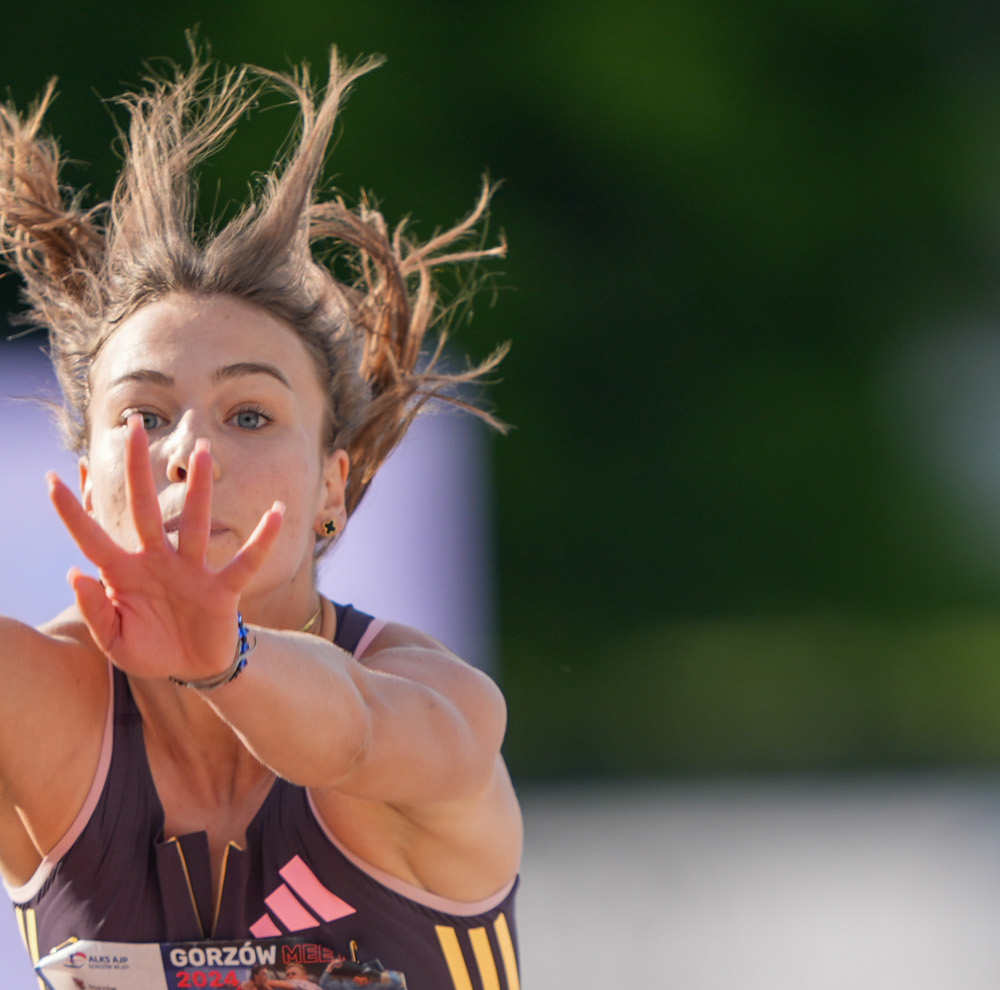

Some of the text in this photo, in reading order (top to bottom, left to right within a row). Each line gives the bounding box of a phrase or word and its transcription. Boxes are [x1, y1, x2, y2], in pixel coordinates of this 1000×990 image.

[169, 941, 346, 967] GORZÓW MEE
[175, 970, 240, 988] 2024
